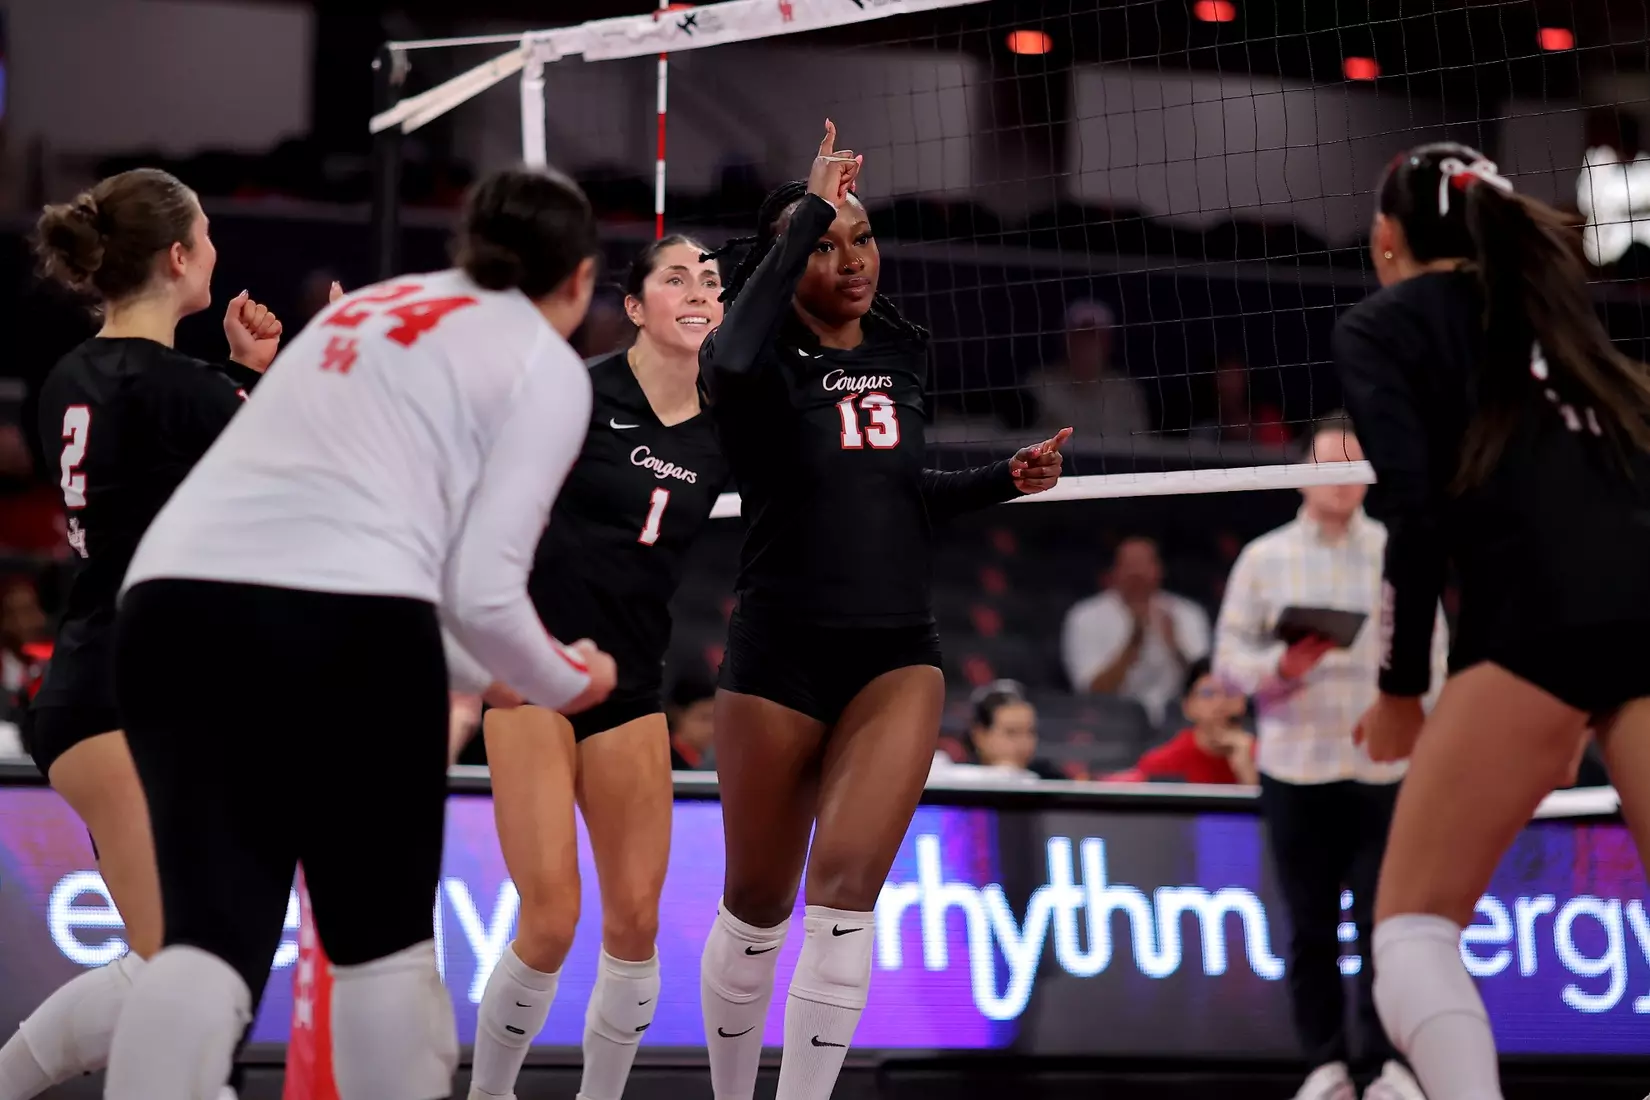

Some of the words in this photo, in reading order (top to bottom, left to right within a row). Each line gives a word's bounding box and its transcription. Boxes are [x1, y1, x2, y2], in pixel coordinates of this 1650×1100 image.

[822, 369, 893, 393] Cougars
[836, 391, 900, 450] 13
[60, 404, 92, 509] 2
[630, 445, 698, 485] Cougars
[637, 487, 671, 547] 1
[875, 834, 1286, 1022] rhythm
